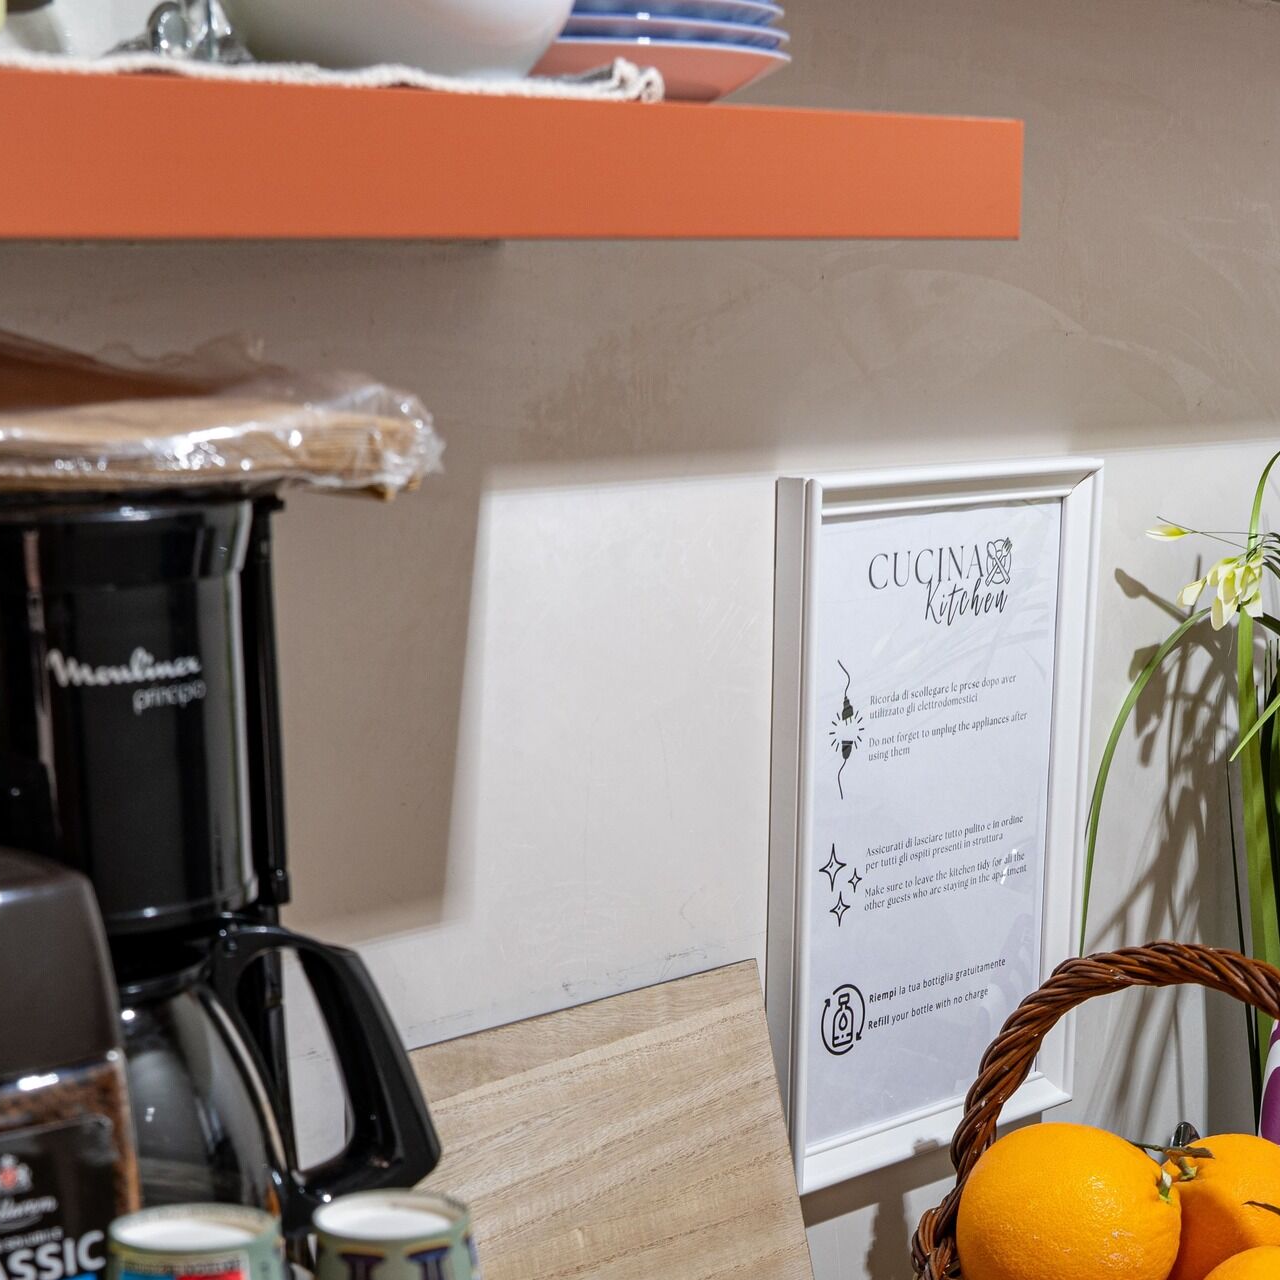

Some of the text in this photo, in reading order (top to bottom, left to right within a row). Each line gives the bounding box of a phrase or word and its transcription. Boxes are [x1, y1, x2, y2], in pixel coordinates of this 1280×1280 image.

[868, 544, 984, 589] CUCINA
[925, 577, 1008, 626] Kitchen
[869, 693, 978, 719] utilizzato gli elettrodomestici
[870, 675, 1016, 705] Ricorda di scollegare le prese dopo aver
[869, 711, 1028, 747] Do not forget to unplug the appliances after
[868, 746, 910, 762] using them
[865, 841, 904, 857] Assicurati
[905, 838, 913, 849] di
[914, 834, 943, 846] lasciare
[944, 829, 963, 839] tutto
[964, 823, 985, 838] pulito
[992, 820, 1000, 829] in
[1001, 815, 1024, 827] ordine
[865, 833, 1003, 873] per tutti gli ospiti presenti in struttura
[864, 886, 885, 898] Make
[886, 883, 903, 893] sure
[904, 879, 913, 889] to
[914, 873, 934, 886] leave
[935, 870, 948, 882] the
[949, 863, 976, 878] kitchen
[977, 860, 990, 873] tidy
[991, 857, 1002, 868] for
[1013, 851, 1025, 862] the
[864, 898, 885, 912] other
[886, 893, 911, 909] guests
[912, 888, 928, 899] who
[929, 887, 942, 895] are
[943, 879, 969, 894] staying
[969, 875, 977, 886] in
[978, 873, 990, 883] the
[869, 958, 1006, 1003] Riempi la tua bottiglia gratuitamente
[868, 987, 988, 1030] Refill your bottle with no charge
